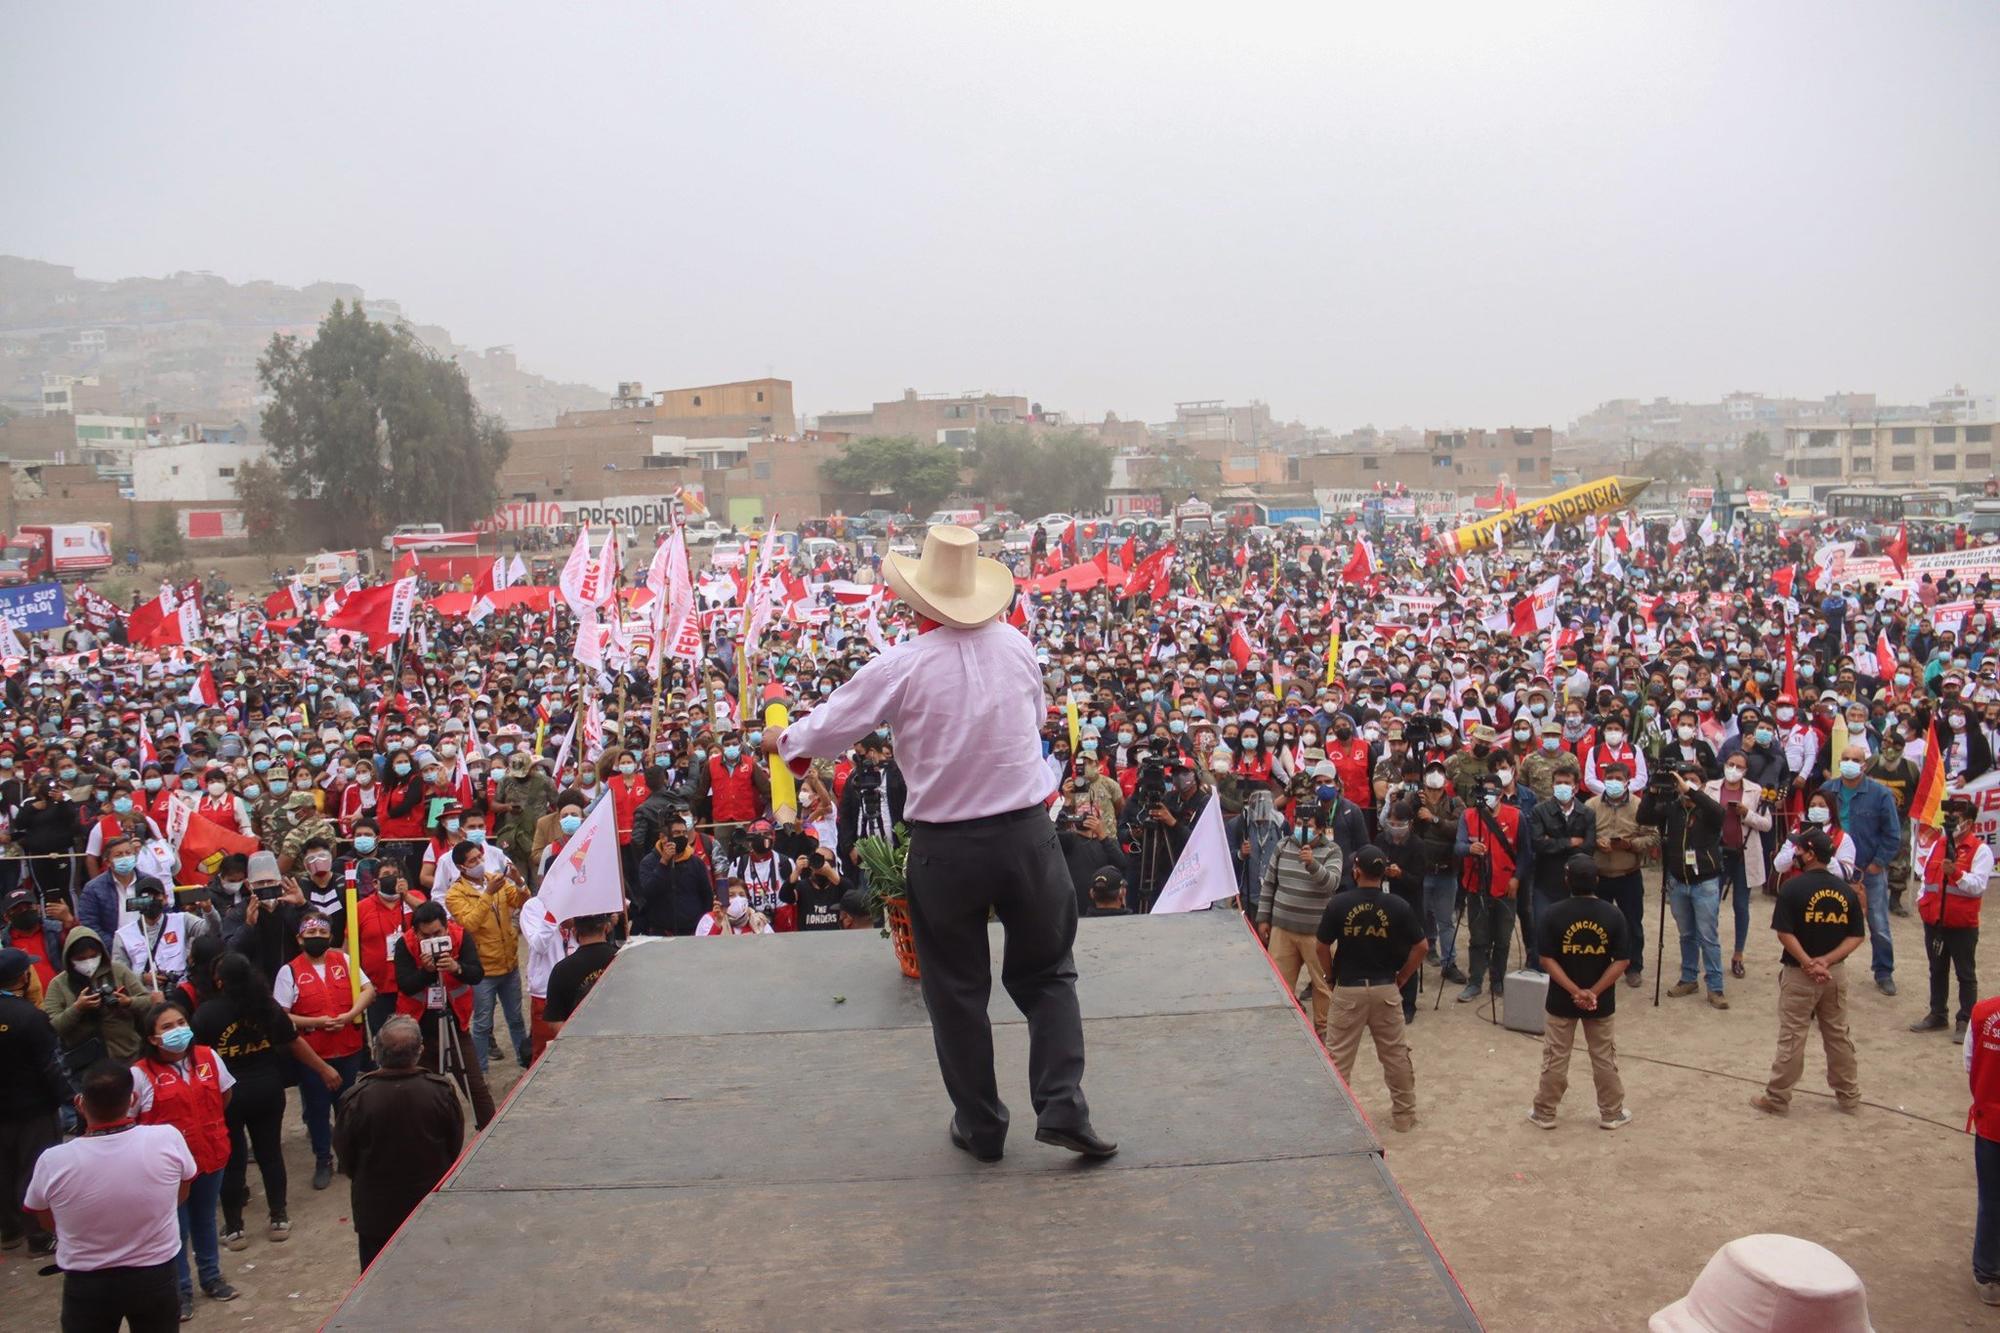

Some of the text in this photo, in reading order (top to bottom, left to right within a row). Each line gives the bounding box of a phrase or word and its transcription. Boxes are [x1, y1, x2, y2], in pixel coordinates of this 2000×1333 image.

[578, 497, 685, 527] PRESIDENTE
[1473, 482, 1622, 548] INDPENDENCIA
[33, 589, 57, 602] SUS
[1806, 889, 1849, 912] LICENCIADOS
[1344, 903, 1390, 927] LICENCIDOS
[1562, 920, 1609, 945] LICENCIADOS
